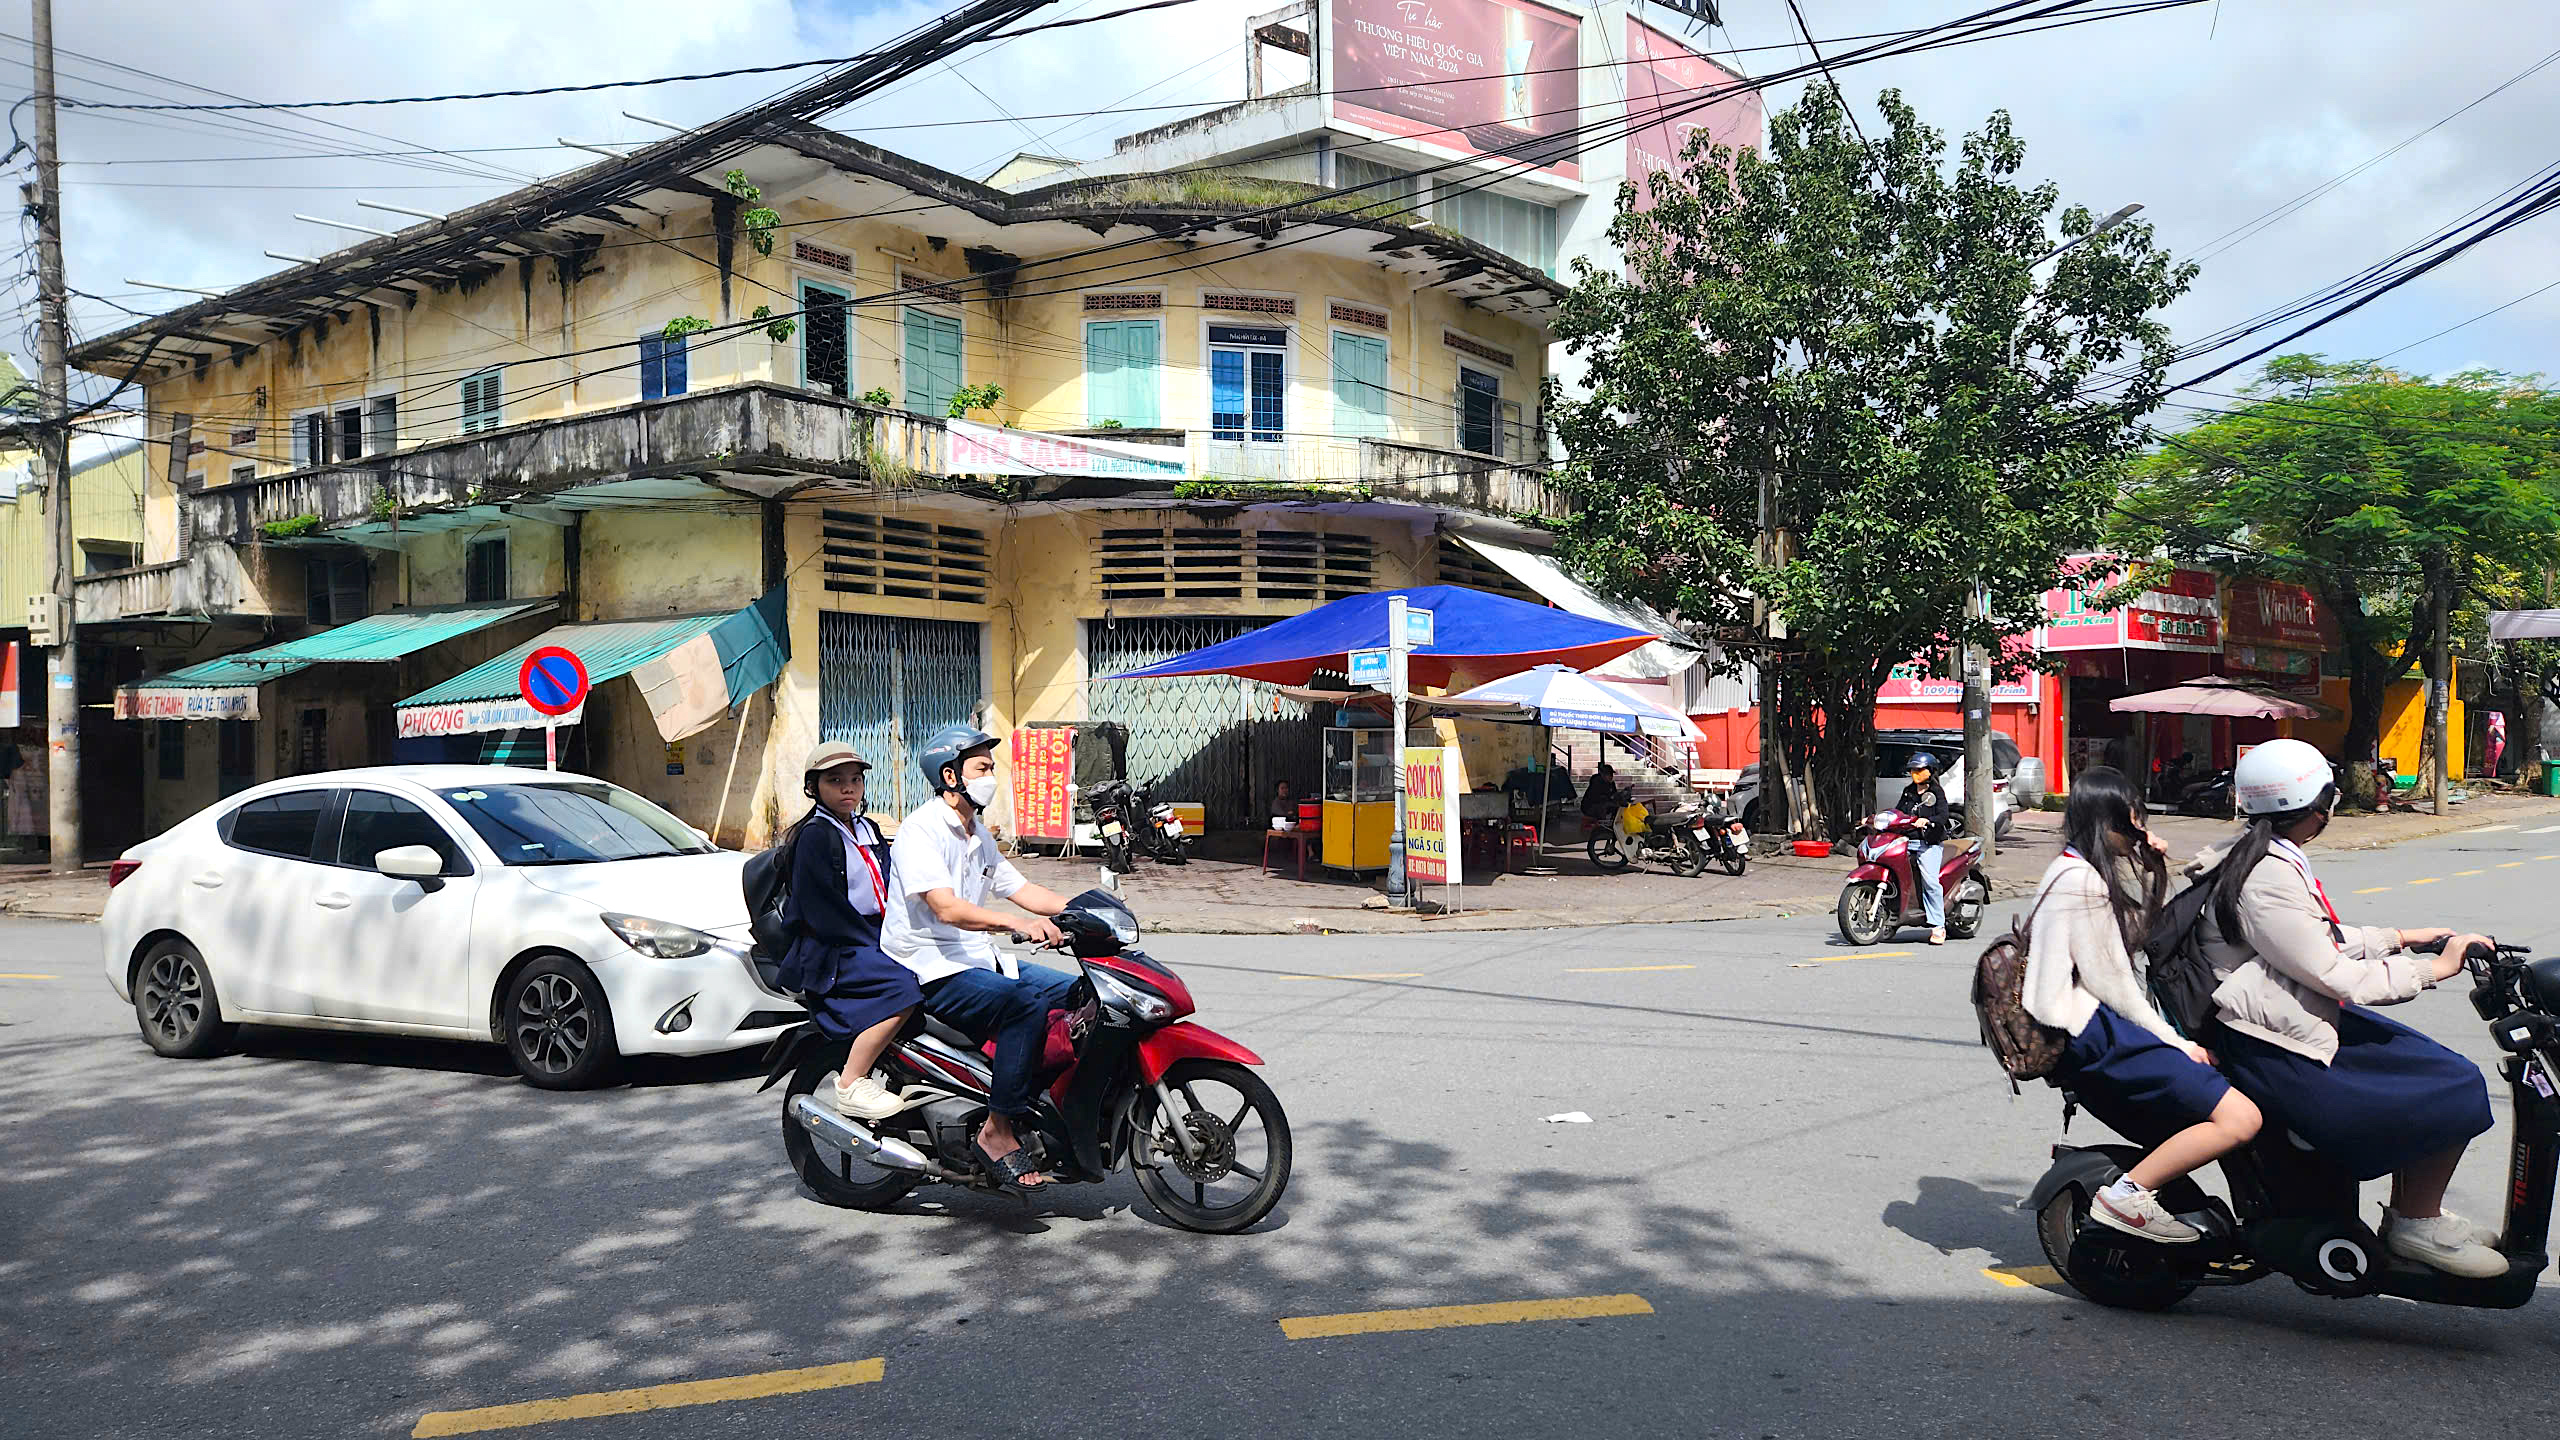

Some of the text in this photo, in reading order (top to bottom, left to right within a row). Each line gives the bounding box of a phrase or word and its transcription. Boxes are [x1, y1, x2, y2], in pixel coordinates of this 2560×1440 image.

[1355, 19, 1403, 44] THƯƠNG
[1406, 33, 1430, 51] HIỆU
[1433, 41, 1464, 61] QUỐC
[1383, 43, 1459, 75] VIỆT NAM 2024
[2083, 616, 2113, 626] Kim
[2258, 587, 2314, 626] WinMart
[1406, 758, 1427, 799] CƠM
[1047, 770, 1065, 827] NGHỊ
[1426, 840, 1431, 851] 5
[1103, 1021, 1130, 1029] HONDA
